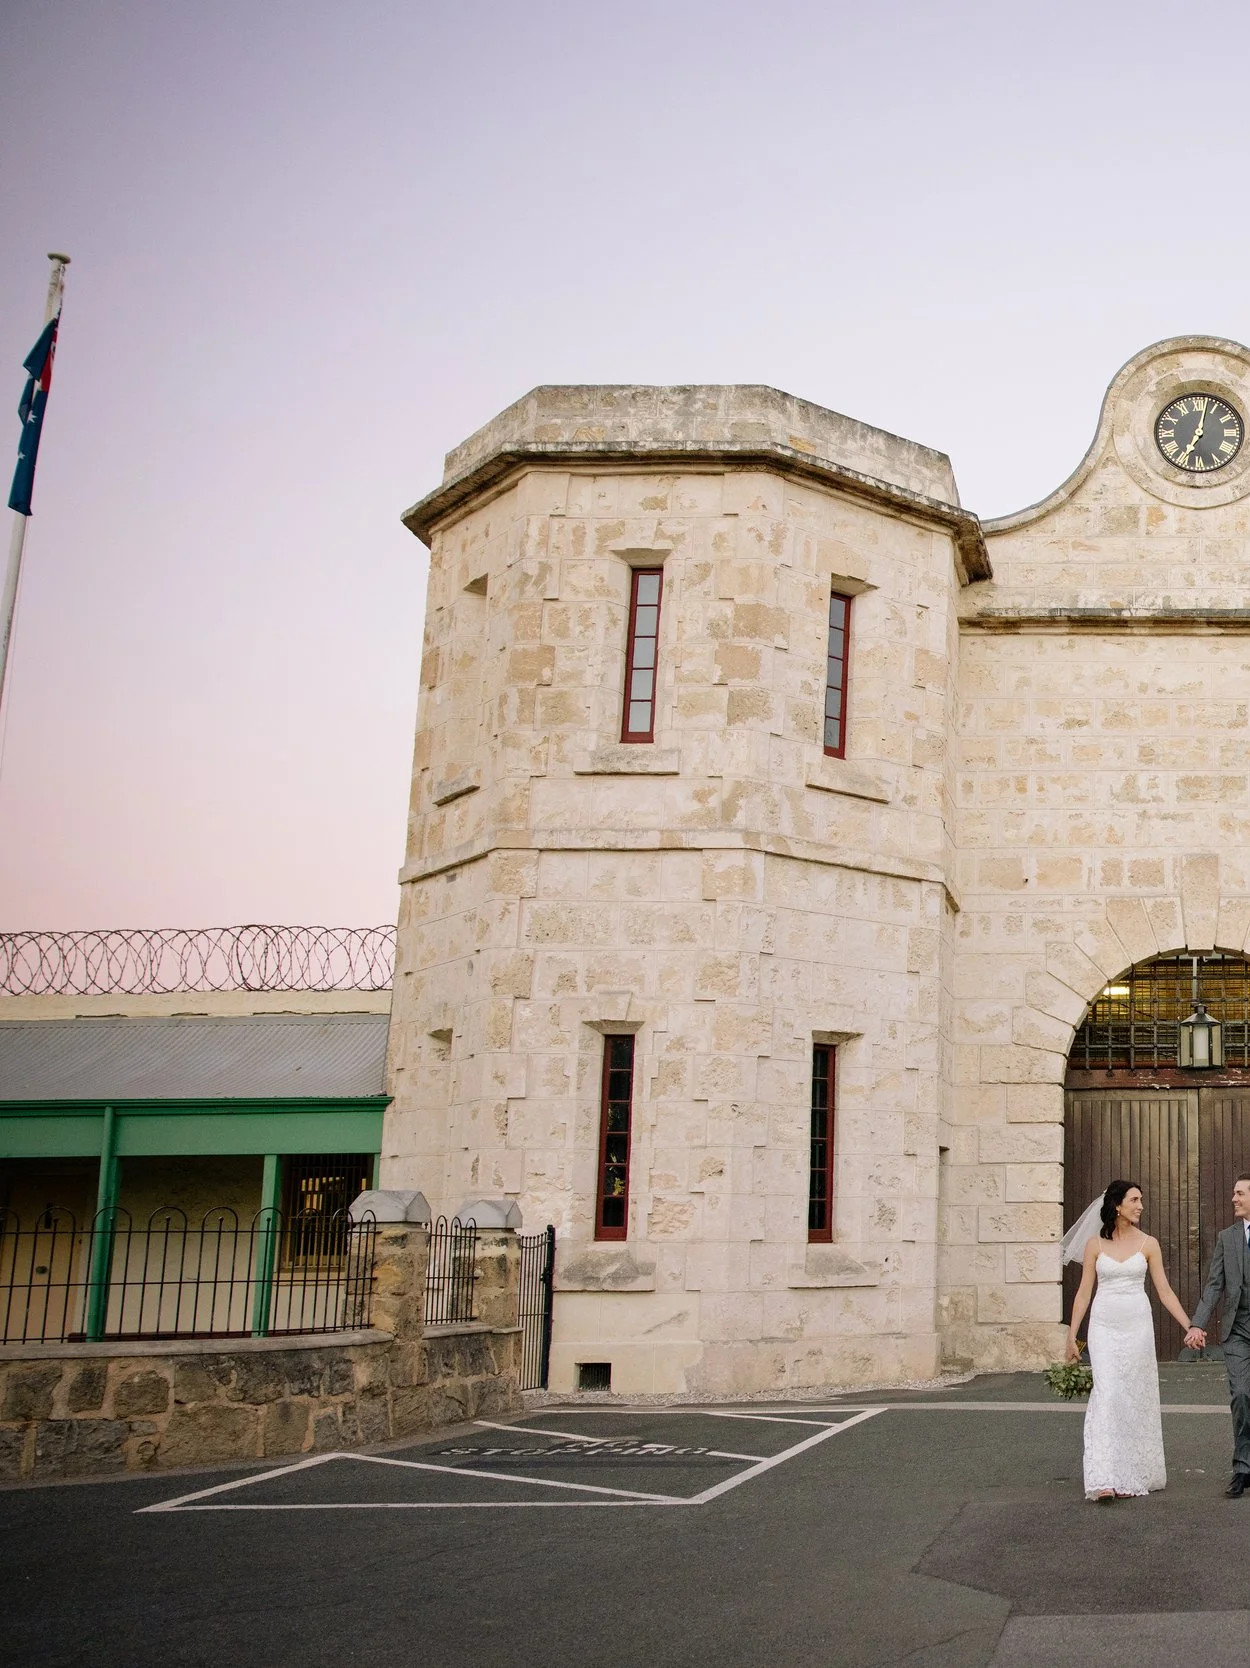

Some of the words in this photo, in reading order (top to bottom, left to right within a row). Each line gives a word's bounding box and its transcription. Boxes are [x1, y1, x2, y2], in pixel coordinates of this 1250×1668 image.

[1193, 400, 1204, 412] XII
[1220, 414, 1232, 424] II
[440, 1447, 709, 1456] STOPPING
